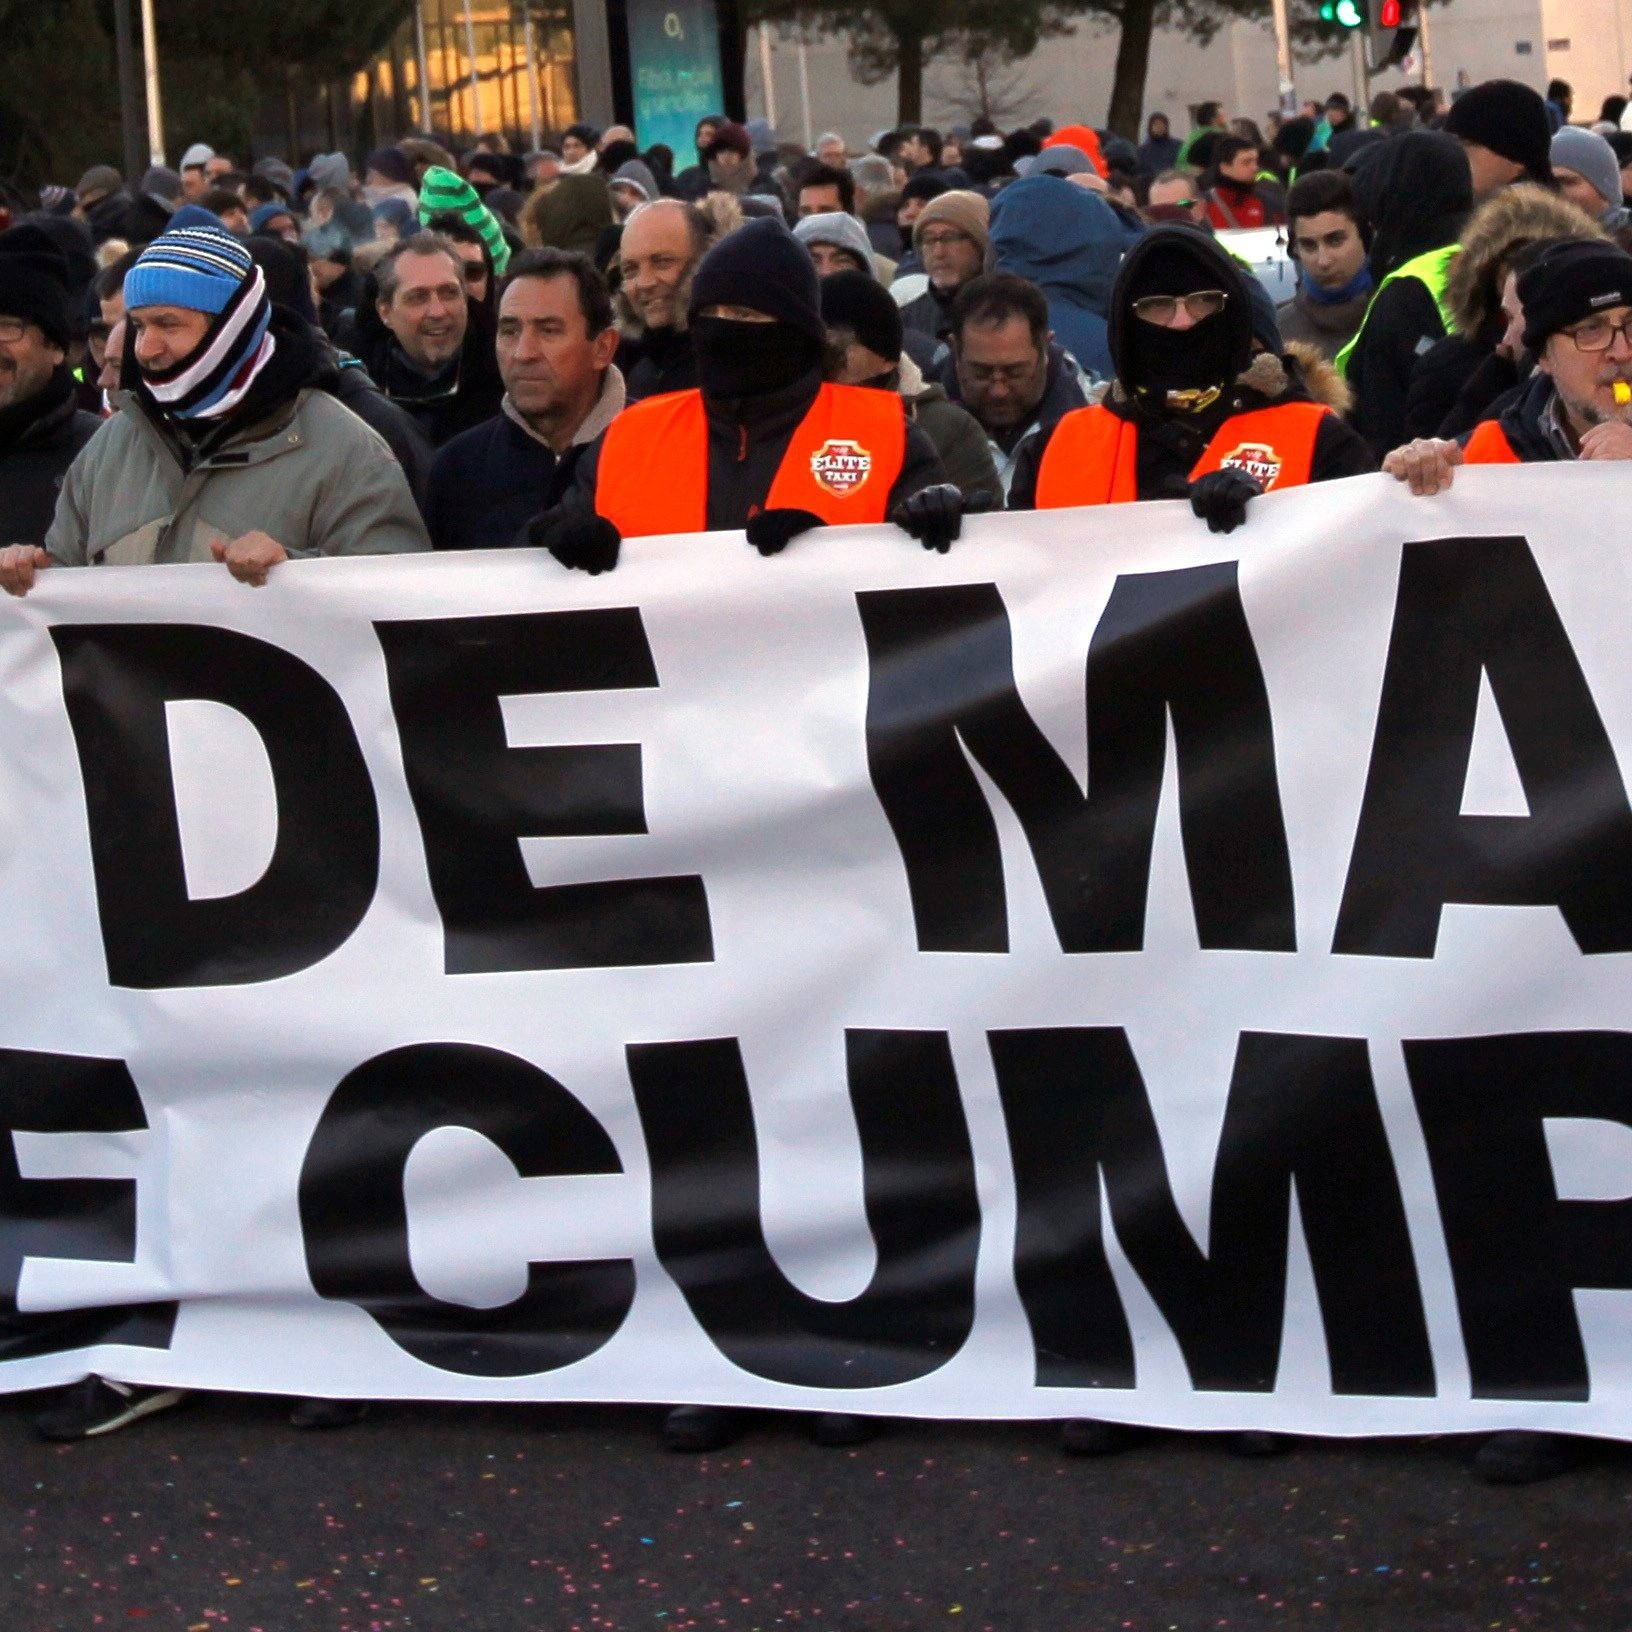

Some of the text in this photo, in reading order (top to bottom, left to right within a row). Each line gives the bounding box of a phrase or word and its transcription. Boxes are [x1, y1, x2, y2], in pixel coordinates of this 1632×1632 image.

[810, 454, 871, 471] ELITE
[825, 470, 857, 482] TAXI
[48, 606, 716, 990] DE
